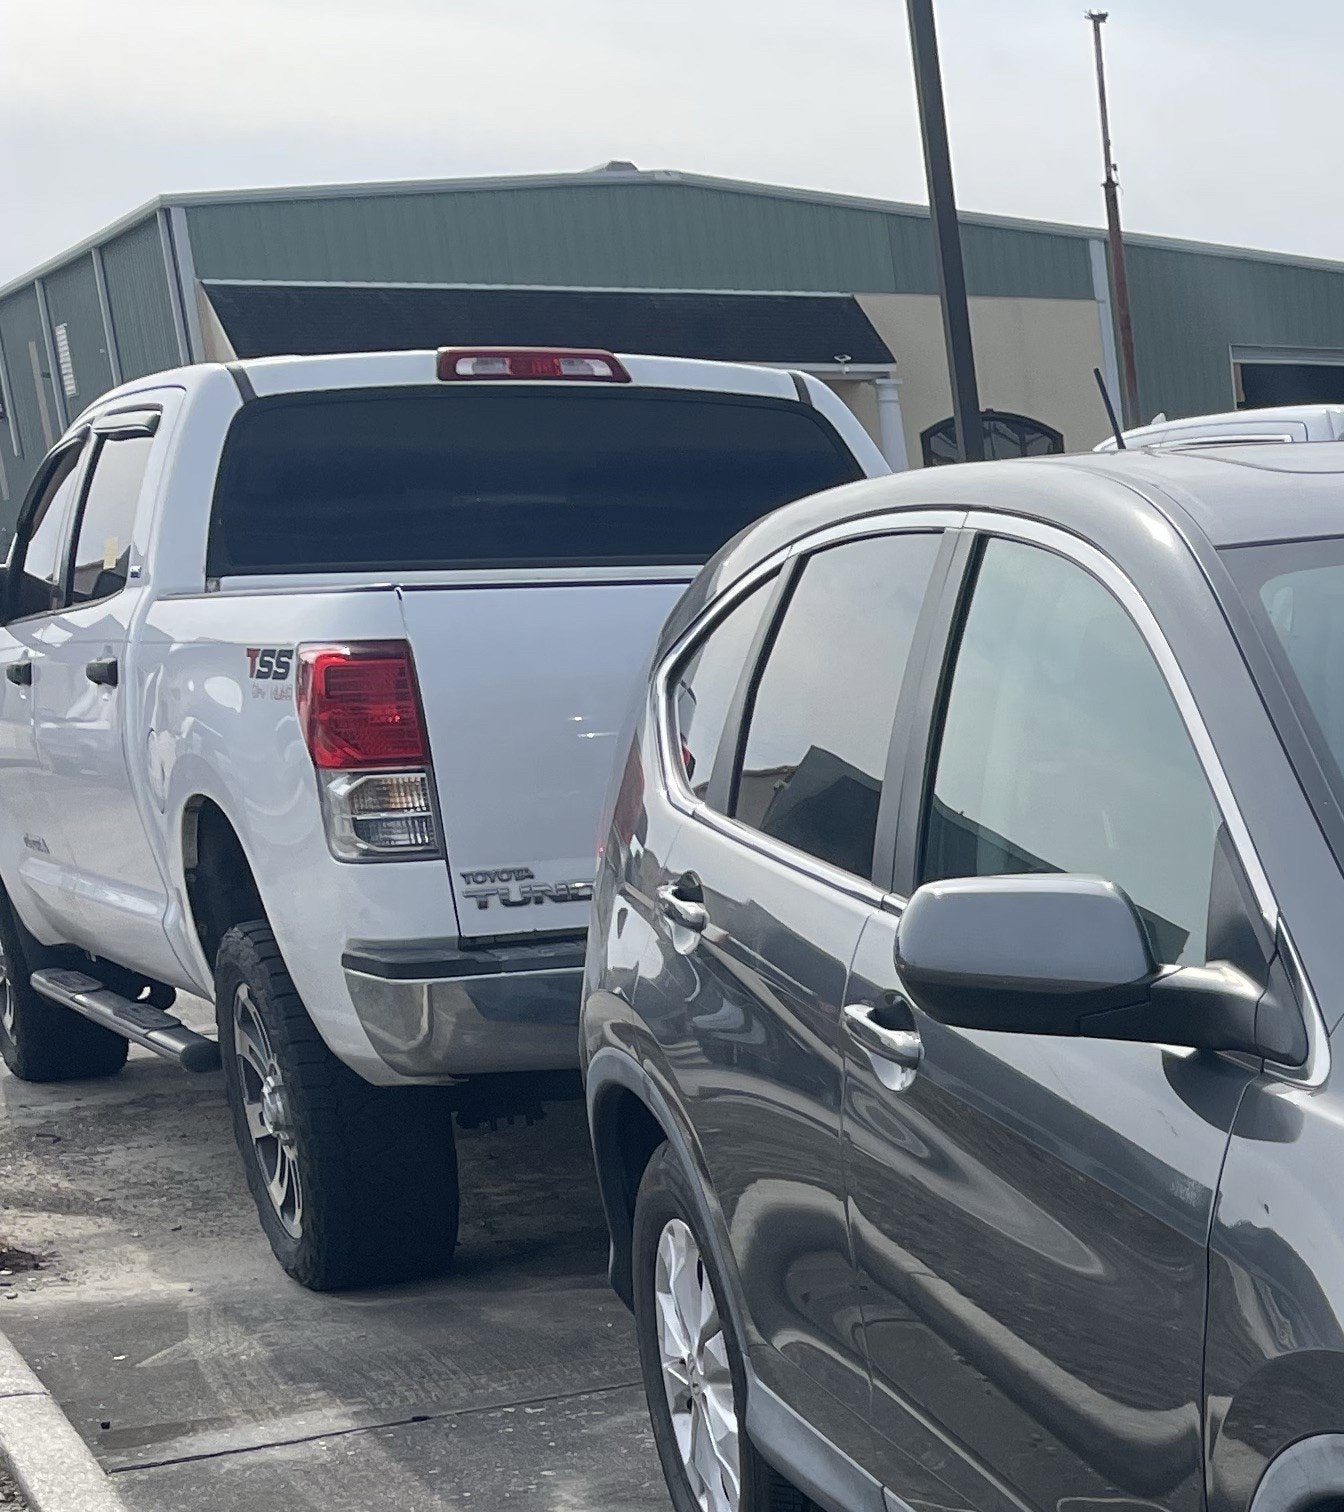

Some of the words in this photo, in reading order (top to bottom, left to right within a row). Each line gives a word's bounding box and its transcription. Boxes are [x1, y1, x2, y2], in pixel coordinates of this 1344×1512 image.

[246, 648, 294, 680] TSS
[460, 867, 534, 885] TOYOTA
[462, 879, 594, 910] TUND
